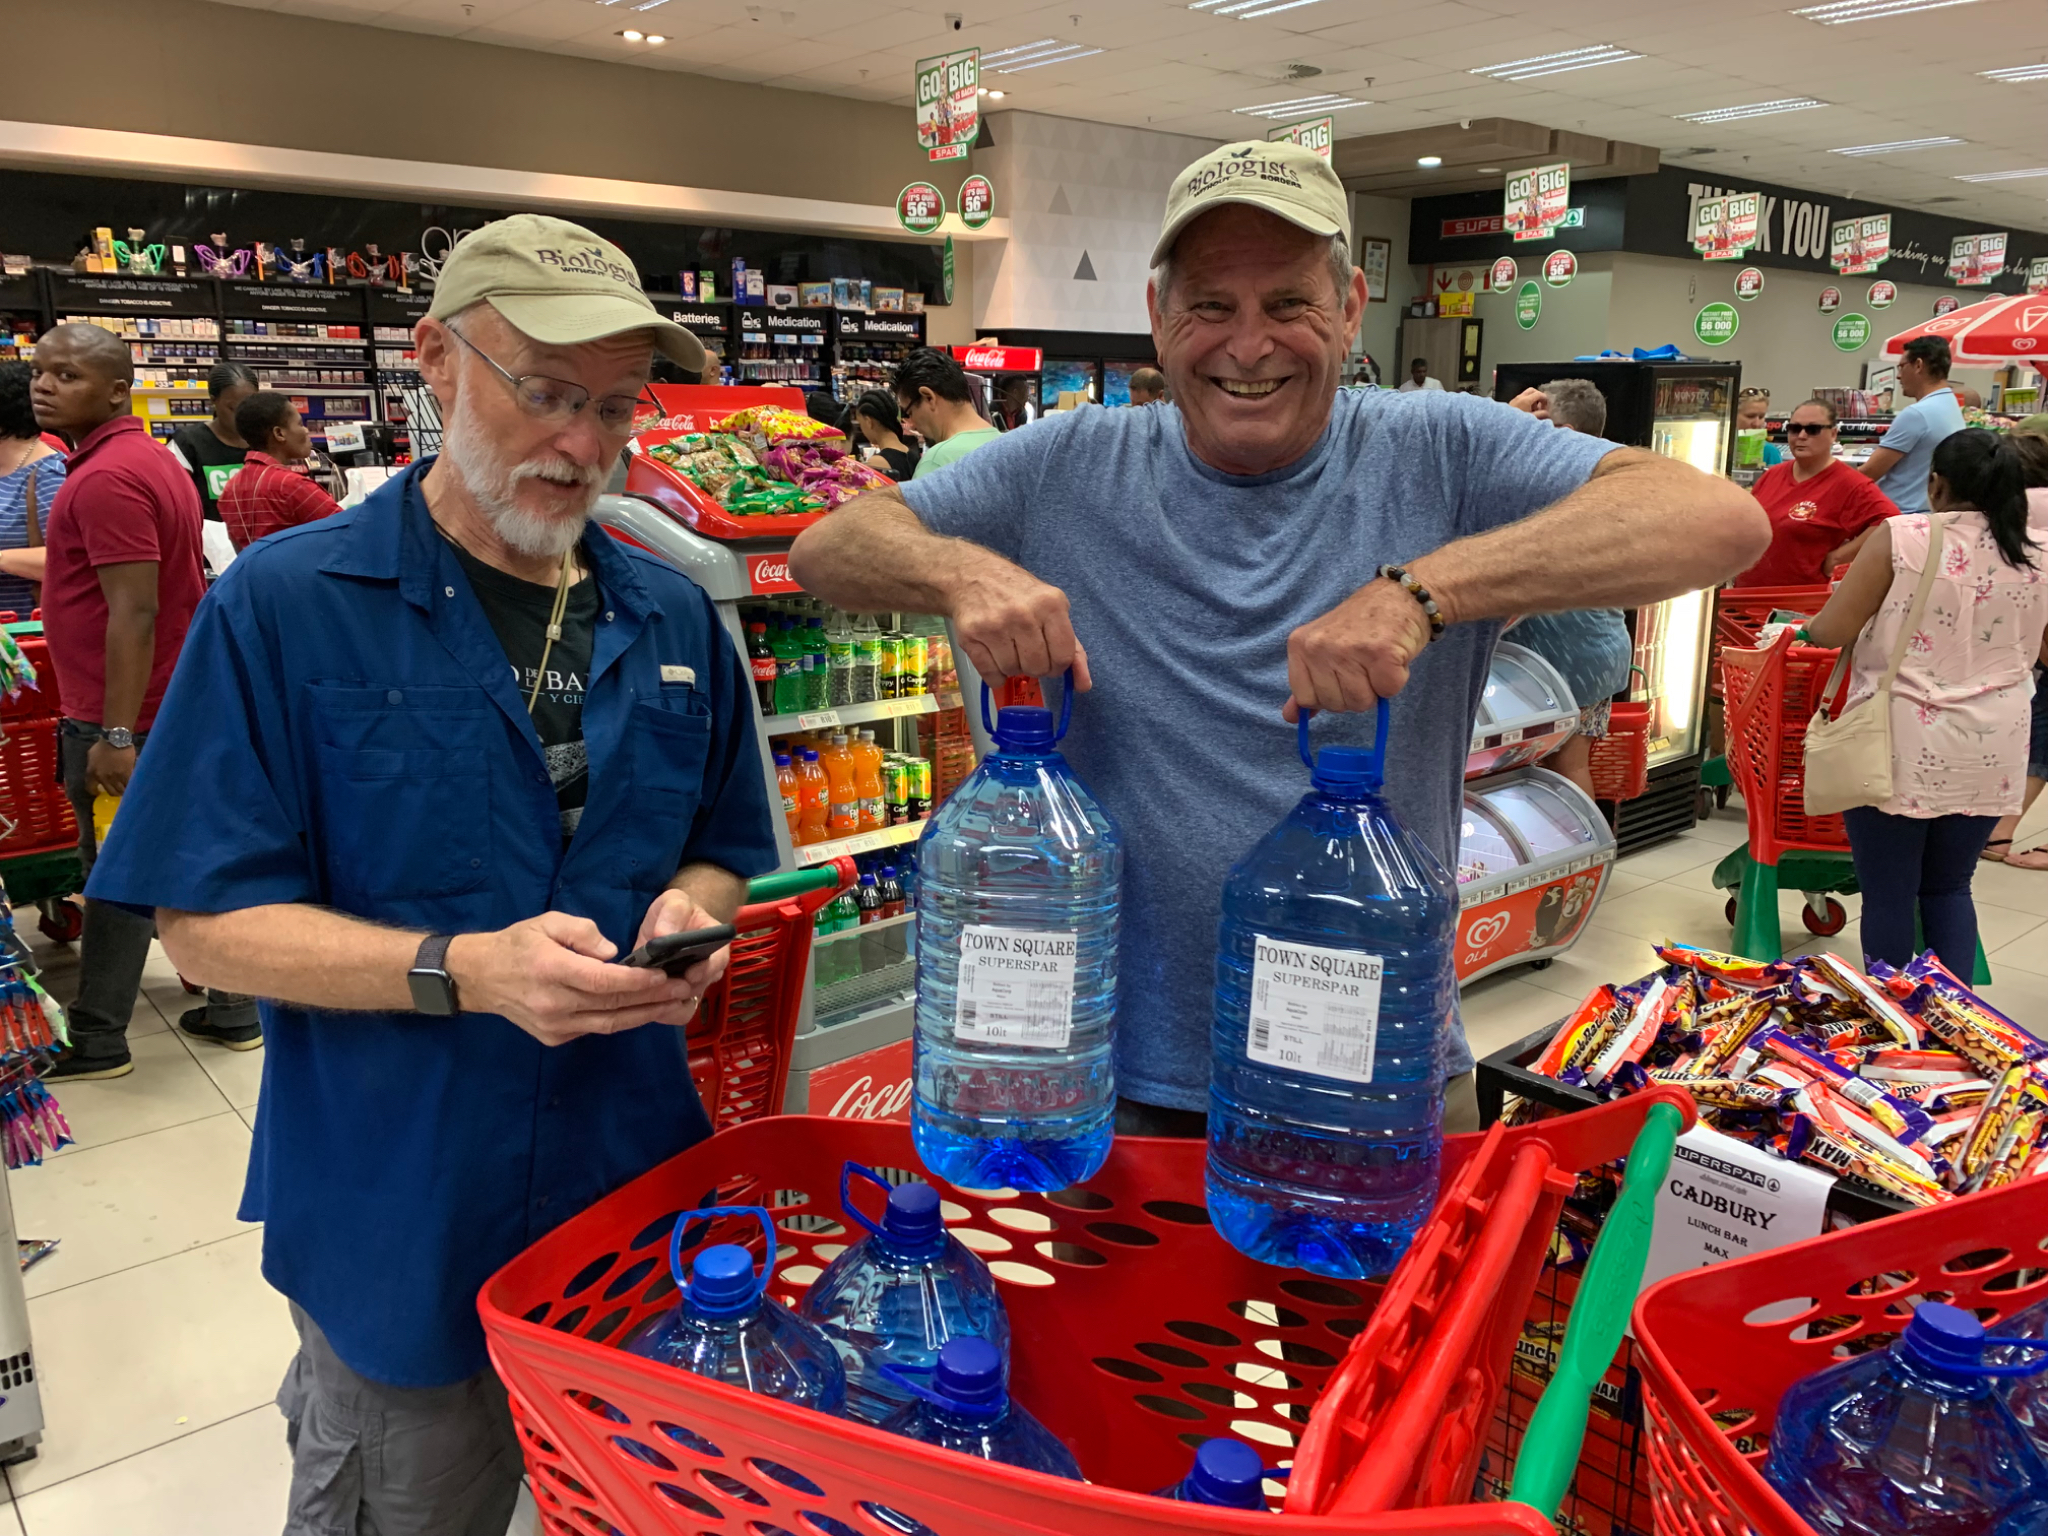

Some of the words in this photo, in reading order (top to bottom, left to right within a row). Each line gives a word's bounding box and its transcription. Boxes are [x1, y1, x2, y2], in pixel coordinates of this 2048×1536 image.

[919, 70, 941, 103] GO
[949, 59, 974, 93] BIG
[1301, 126, 1328, 149] BIG
[935, 146, 957, 158] SPAR
[1187, 156, 1300, 197] Biologists
[1260, 174, 1302, 189] BORDERS
[1509, 177, 1530, 200] GO
[1539, 169, 1566, 192] BIG
[1700, 207, 1721, 224] GO
[1729, 198, 1755, 218] BIG
[1455, 221, 1500, 232] SUPE
[1521, 230, 1544, 239] SPAR
[1781, 199, 1830, 259] YOU
[1835, 226, 1854, 243] GO
[1862, 220, 1887, 237] BIG
[1711, 250, 1733, 258] SPAR
[1954, 242, 1973, 256] GO
[1980, 237, 2003, 253] BIG
[561, 266, 605, 277] WITHOUT
[673, 311, 720, 325] Batteries
[768, 315, 821, 328] Medication
[864, 320, 914, 332] Medication
[1701, 321, 1713, 330] 56
[1714, 321, 1732, 330] 000
[1837, 329, 1850, 338] 56
[1850, 329, 1865, 337] 000
[965, 348, 1006, 368] Coca-Cola
[1674, 391, 1710, 401] MONSTER
[651, 413, 696, 432] oca-Cola
[546, 670, 590, 691] BA
[906, 676, 927, 686] Cappy
[550, 693, 560, 703] Y
[964, 932, 1010, 952] TOWN
[1012, 938, 1076, 957] SQUARE
[978, 956, 1058, 973] SUPERSPAR
[1257, 944, 1307, 969] TOWN
[1310, 954, 1381, 981] SQUARE
[1464, 952, 1488, 965] OLA
[1272, 971, 1360, 997] SUPERSPAR
[1828, 1020, 1855, 1037] MAX
[1859, 1022, 1885, 1038] Bar
[1921, 1009, 1960, 1038] MAX
[1284, 1034, 1304, 1045] STILL
[1808, 1137, 1850, 1169] MAX
[1674, 1146, 1767, 1188] UPERSPAR
[1669, 1179, 1778, 1231] CADBURY
[1687, 1216, 1721, 1237] LUNCH
[1723, 1231, 1749, 1247] BAR
[1704, 1242, 1730, 1260] MAX
[1517, 1339, 1557, 1364] unch
